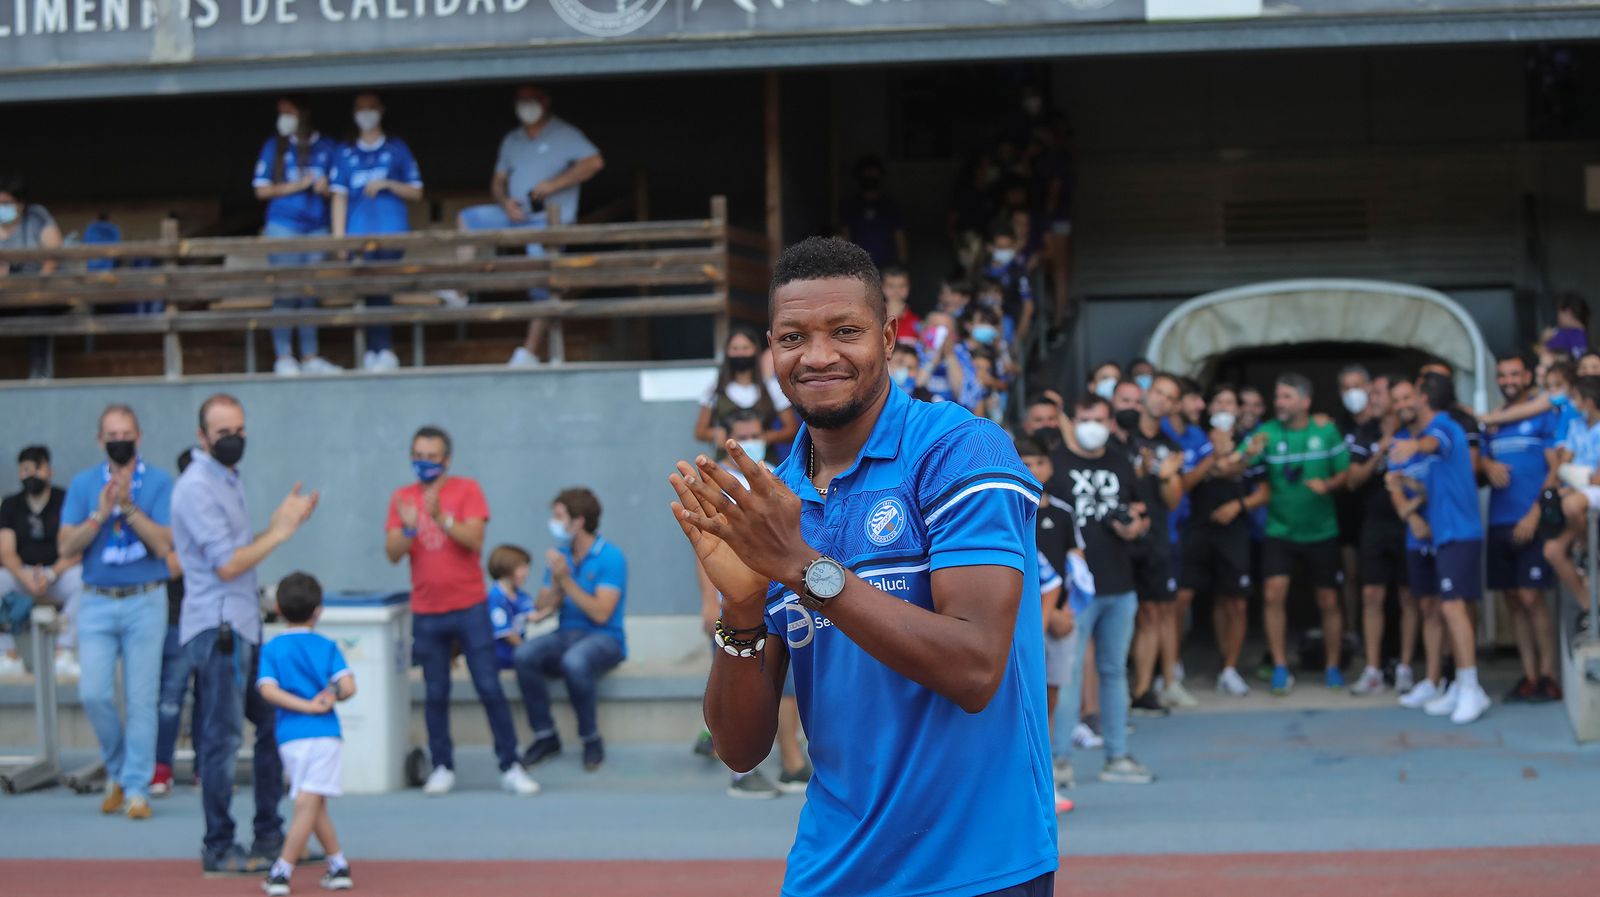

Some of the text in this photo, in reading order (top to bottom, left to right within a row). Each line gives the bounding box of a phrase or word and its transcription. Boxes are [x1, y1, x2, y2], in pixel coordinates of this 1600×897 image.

[0, 0, 219, 37] IMENS
[241, 0, 298, 25] DE
[815, 617, 834, 628] Se
